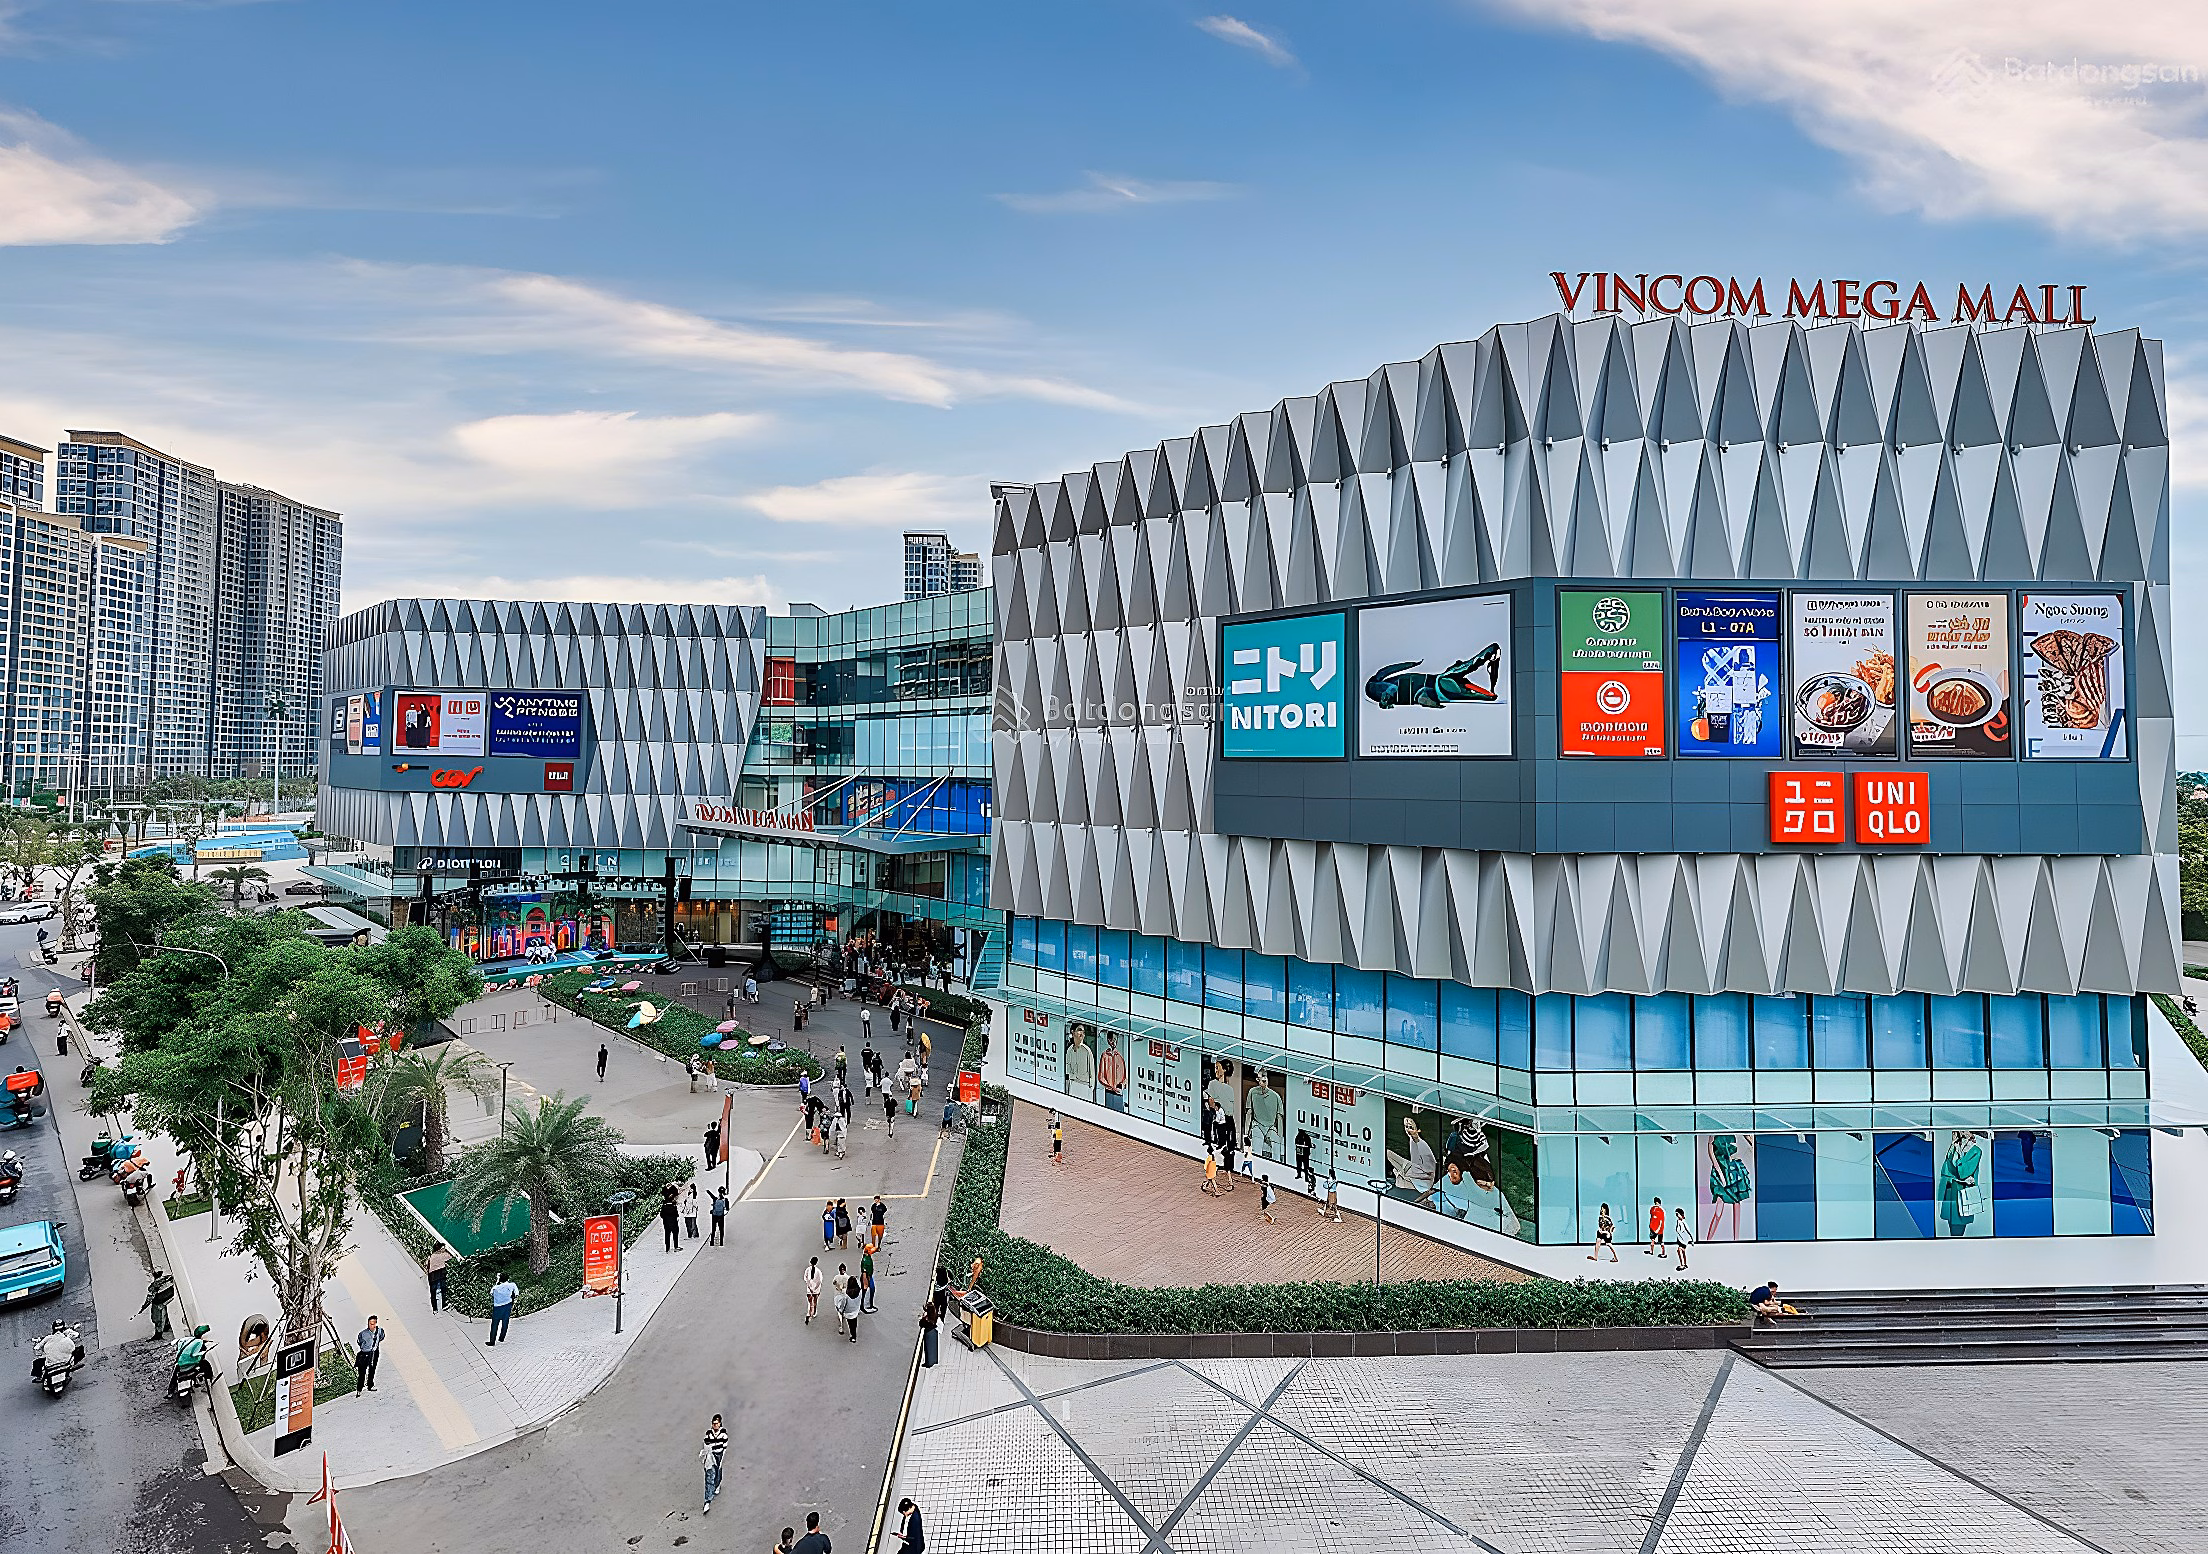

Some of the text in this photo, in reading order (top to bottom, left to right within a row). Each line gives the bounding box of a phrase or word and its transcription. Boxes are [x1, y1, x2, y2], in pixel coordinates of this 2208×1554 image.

[1550, 272, 2097, 325] VINCOM MEGA MALL
[1231, 640, 1337, 695] ニトリ
[1231, 701, 1337, 730] NITORI
[1867, 781, 1916, 805] UNI
[1868, 810, 1921, 839] QLO
[1137, 1066, 1192, 1092] UNIQLO
[1297, 1109, 1372, 1142] UNIQLO
